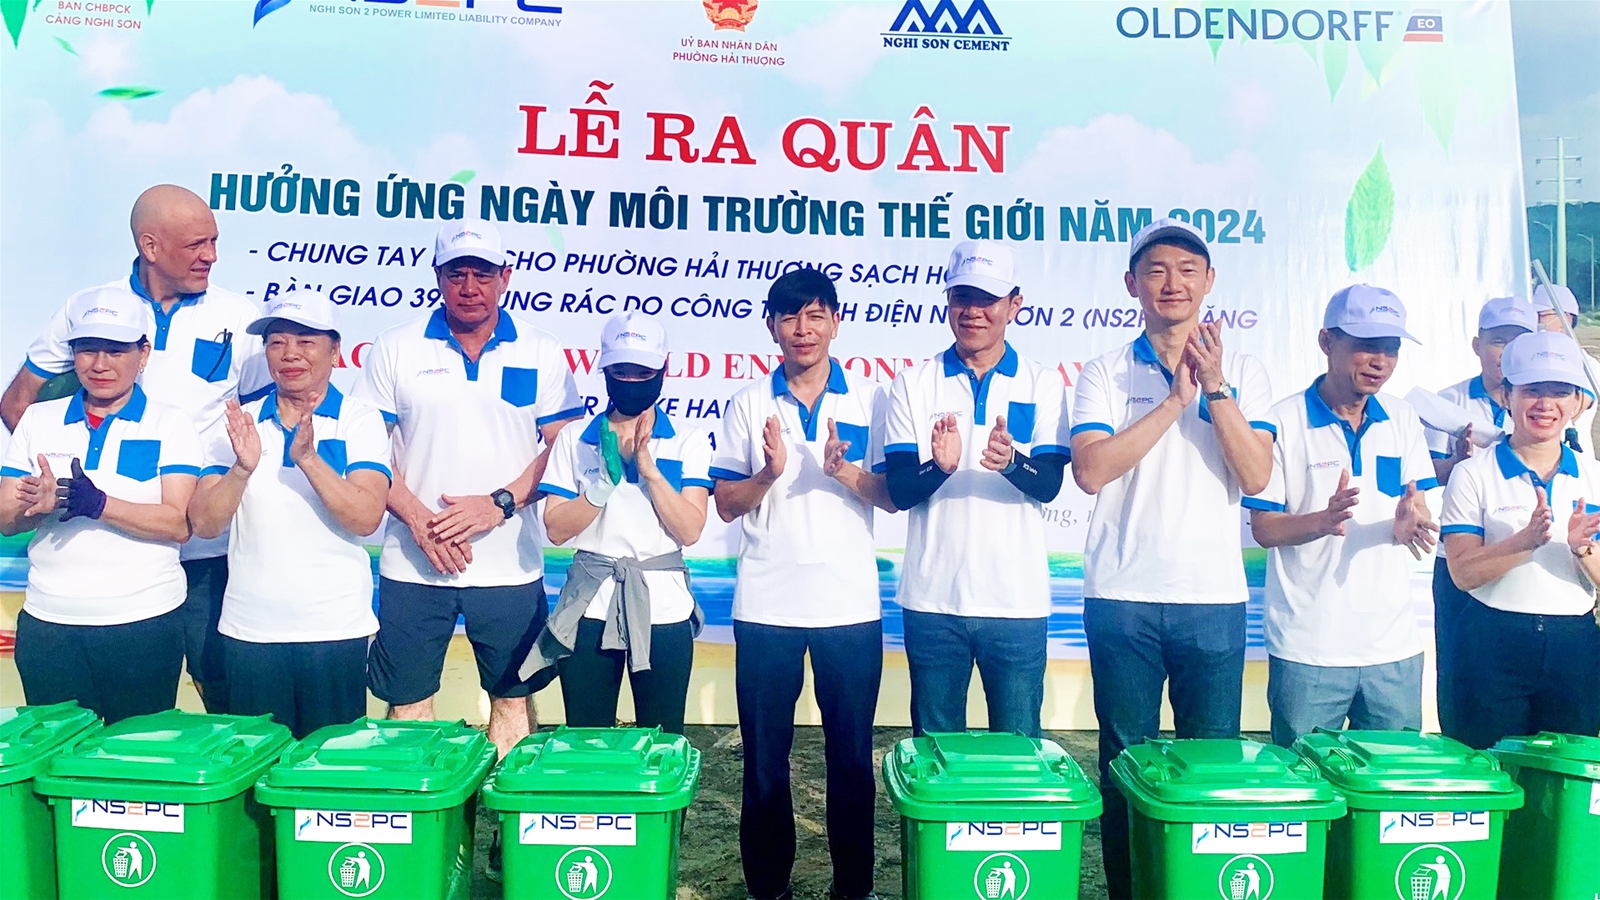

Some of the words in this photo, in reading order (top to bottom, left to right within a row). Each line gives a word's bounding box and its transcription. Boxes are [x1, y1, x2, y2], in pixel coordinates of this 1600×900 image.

[58, 1, 81, 10] BAN
[85, 2, 131, 14] CHBPCK
[309, 4, 336, 14] NGHI
[338, 6, 361, 15] SON
[363, 7, 370, 16] 2
[372, 8, 411, 18] POWER
[414, 10, 456, 21] LIMITED
[458, 13, 508, 24] LIABILITY
[510, 16, 562, 27] COMPANY
[45, 13, 81, 25] CẢNG
[84, 17, 114, 27] NGHI
[117, 19, 141, 29] SƠN
[1116, 6, 1394, 41] OLDENDORFF
[1416, 18, 1436, 29] EO
[697, 39, 719, 48] BAN
[721, 39, 752, 50] NHÂN
[754, 40, 778, 51] DÂN
[883, 37, 918, 48] NGHI
[921, 38, 950, 49] SON
[953, 39, 1010, 51] CEMENT
[672, 51, 718, 63] PHƯỜNG
[721, 52, 739, 63] HẢI
[742, 55, 786, 67] THƯỢNG
[517, 80, 620, 159] LỄ
[645, 112, 757, 165] RA
[782, 106, 1010, 173] QUÂN
[209, 163, 361, 217] HƯỞNG
[376, 173, 465, 221] ỨNG
[480, 180, 596, 227] NGÀY
[609, 186, 689, 231] MÔI
[702, 189, 865, 236] TRƯỜNG
[878, 192, 954, 239] THẾ
[965, 198, 1044, 241] GIỚI
[1060, 199, 1152, 243] NĂM
[267, 241, 369, 266] CHUNG
[376, 246, 427, 268] TAY
[563, 249, 678, 277] PHƯỜNG
[684, 251, 729, 279] HẢI
[849, 263, 919, 288] SẠCH
[329, 284, 404, 307] GIAO
[559, 287, 617, 315] RÁC
[623, 295, 664, 316] DO
[670, 293, 753, 320] CÔNG
[865, 299, 923, 327] ĐIỆN
[1060, 308, 1075, 327] 2
[92, 798, 180, 817] NS2PC
[316, 812, 408, 829] NS2PC
[541, 815, 632, 830] NS2PC
[1400, 810, 1485, 828] NS2PC
[1214, 821, 1303, 838] NS2PC
